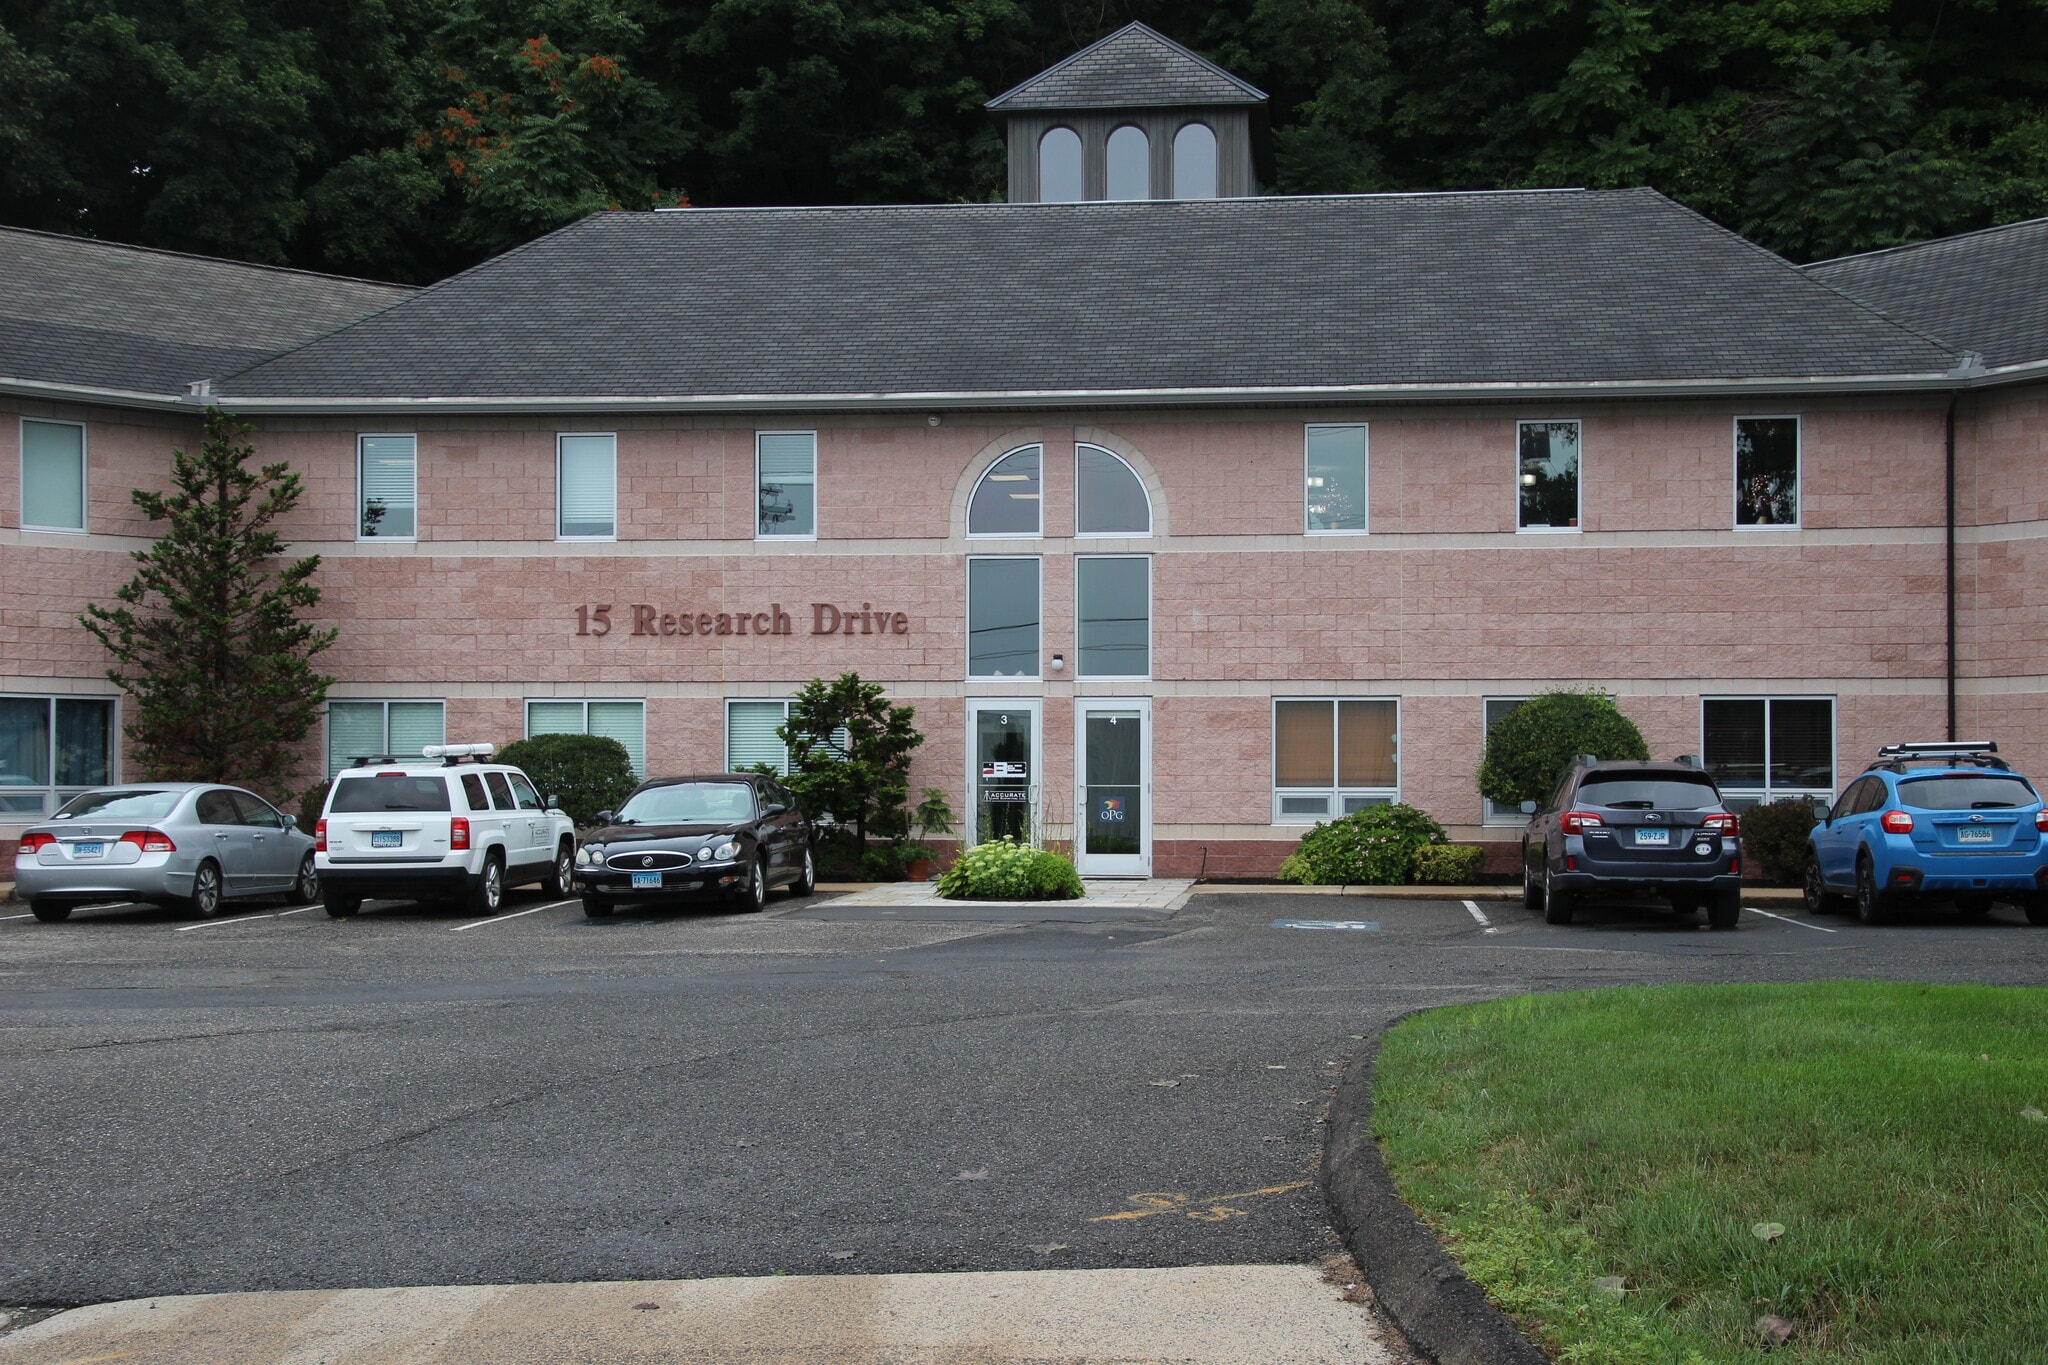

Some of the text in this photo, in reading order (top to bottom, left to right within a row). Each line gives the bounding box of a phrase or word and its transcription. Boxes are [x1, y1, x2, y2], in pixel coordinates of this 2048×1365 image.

[574, 602, 909, 636] 15 Research Drive
[1000, 714, 1008, 725] 3
[1109, 715, 1117, 726] 4
[1101, 809, 1123, 820] OPG
